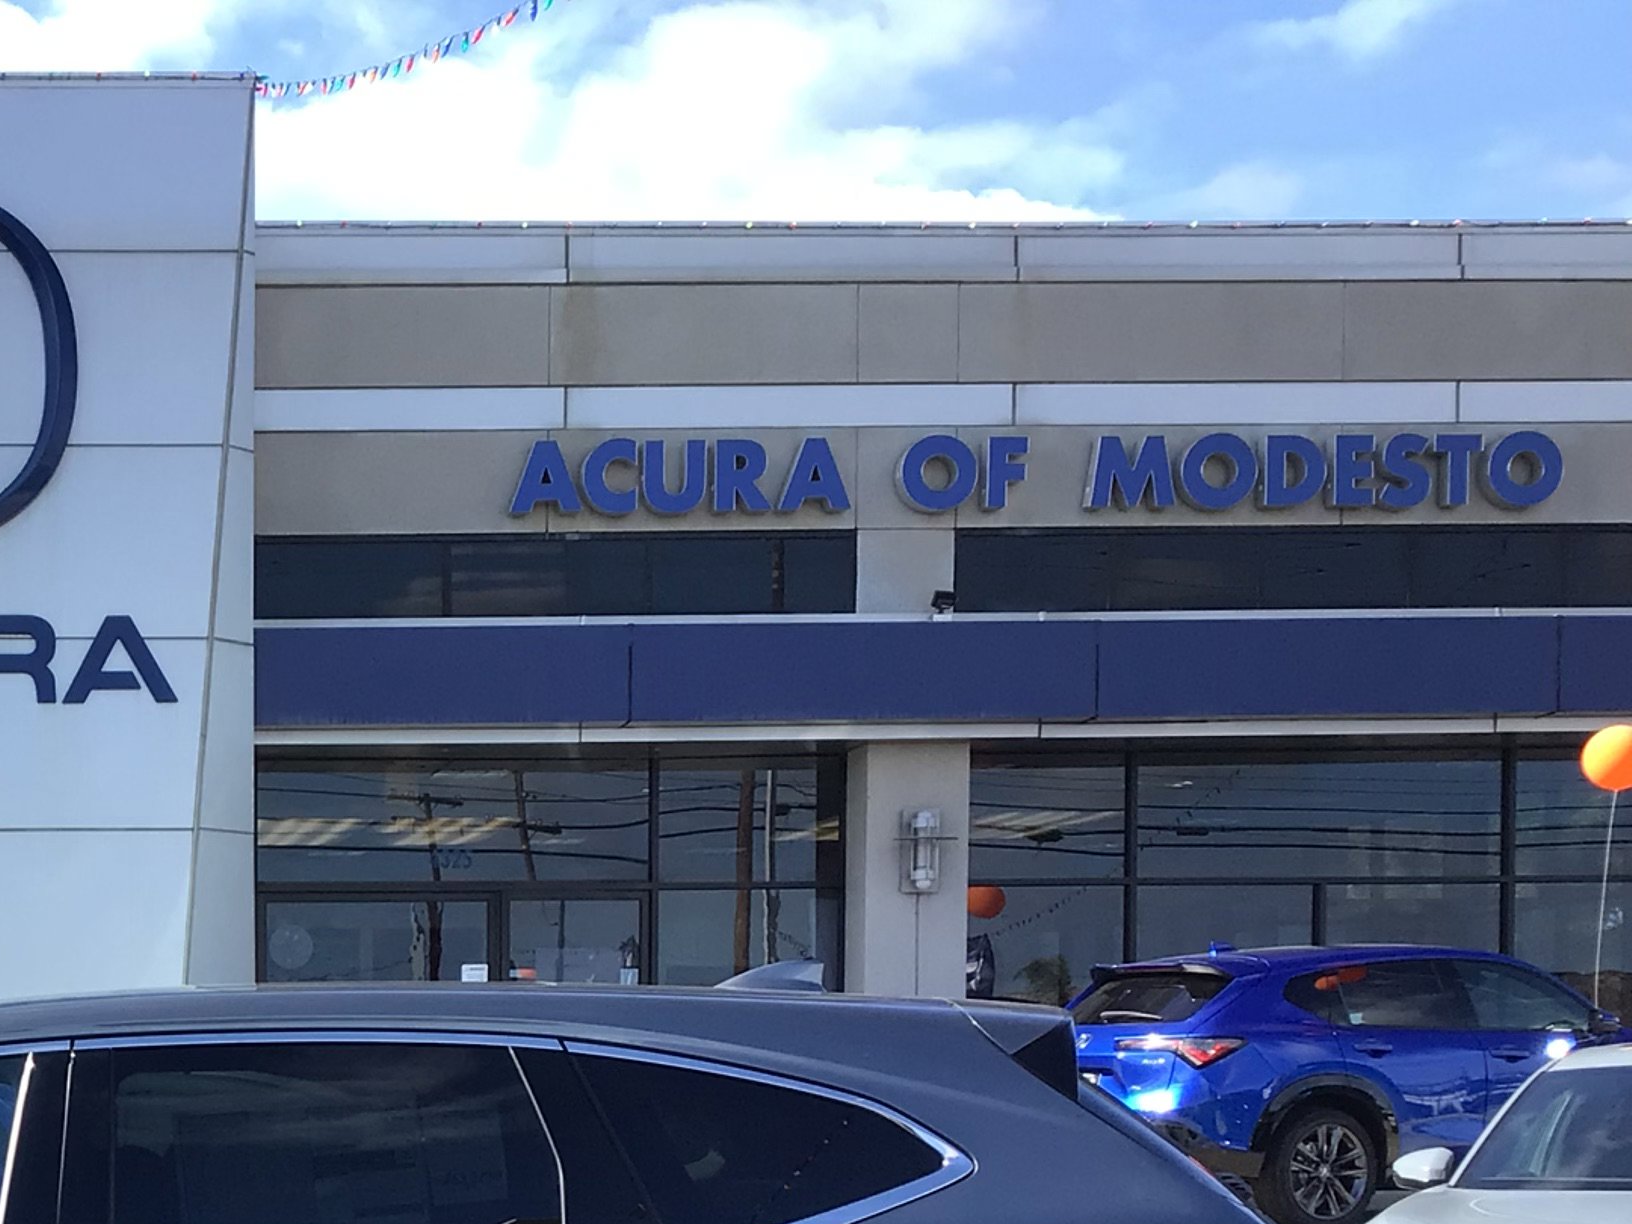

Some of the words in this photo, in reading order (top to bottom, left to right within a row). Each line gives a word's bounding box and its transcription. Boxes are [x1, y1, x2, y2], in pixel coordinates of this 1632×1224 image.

[509, 436, 851, 515] ACURA
[898, 434, 1029, 512] OF
[1083, 431, 1565, 511] MODESTO
